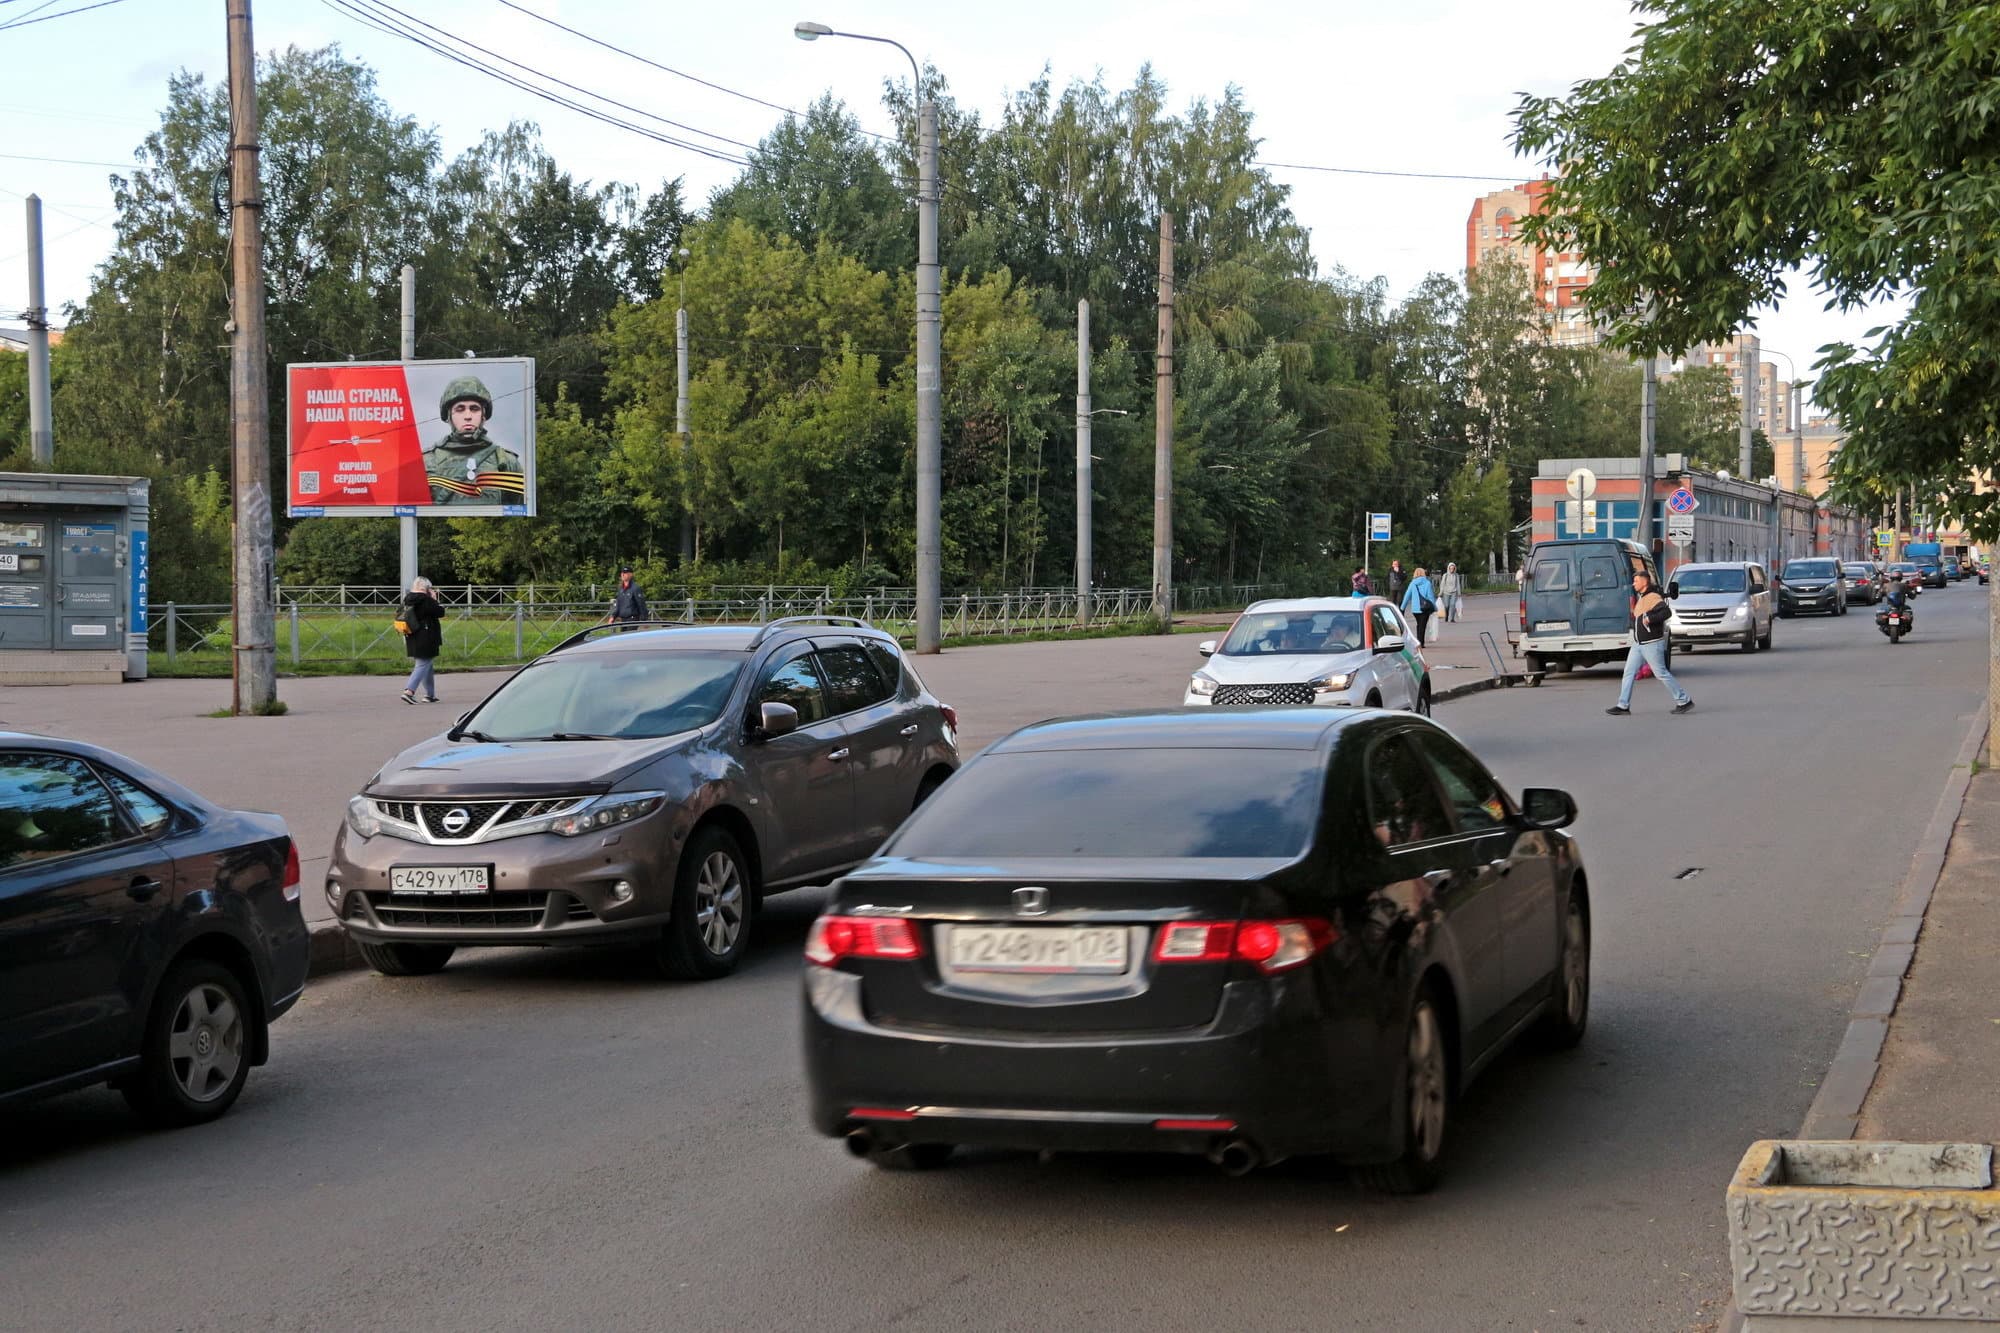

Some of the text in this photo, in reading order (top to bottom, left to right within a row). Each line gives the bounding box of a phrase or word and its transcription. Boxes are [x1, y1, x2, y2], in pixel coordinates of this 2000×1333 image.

[307, 388, 403, 404] НАША СТРАНА,
[306, 406, 404, 423] НАША ПОБЕДА!
[338, 461, 372, 471] КИРИЛЛ
[333, 474, 378, 485] СЕРДЮКОВ
[138, 541, 147, 621] ТУАЛЕТ
[1540, 563, 1569, 590] Z
